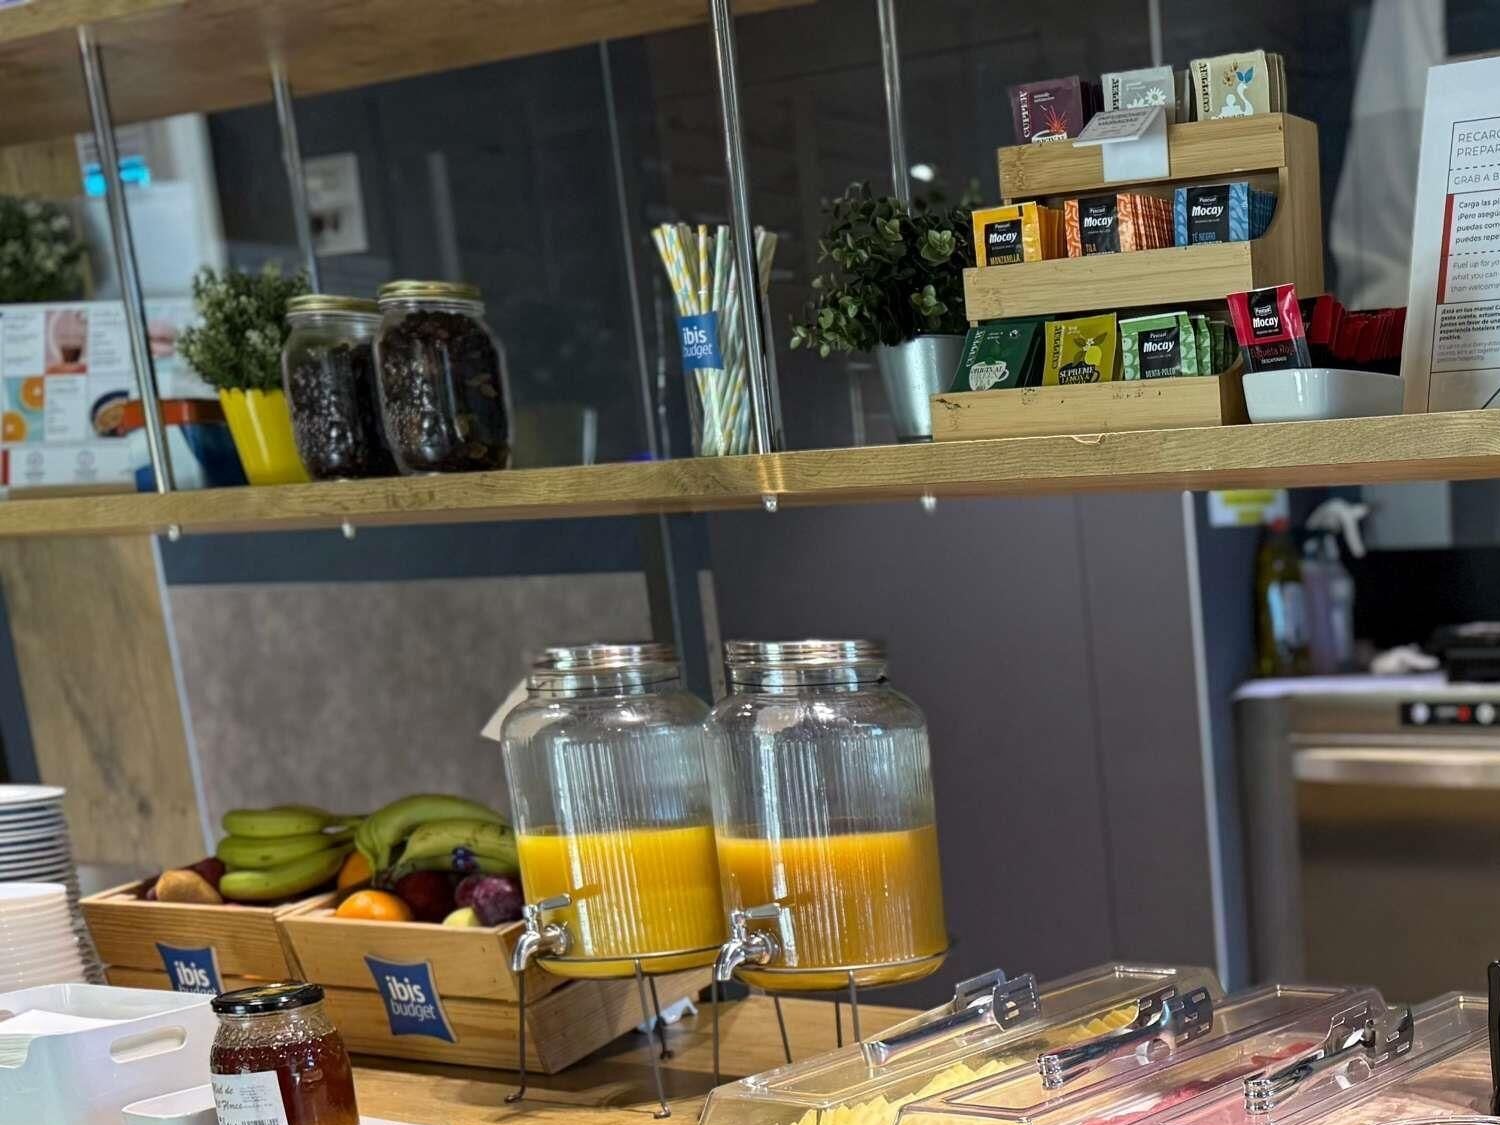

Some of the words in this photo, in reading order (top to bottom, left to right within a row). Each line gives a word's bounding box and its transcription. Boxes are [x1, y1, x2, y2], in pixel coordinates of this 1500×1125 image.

[1199, 63, 1210, 112] CUPPER
[1454, 175, 1480, 185] GRAB
[1484, 174, 1490, 182] A
[1459, 201, 1480, 209] Carga
[1192, 206, 1224, 217] Mocay
[1084, 216, 1113, 228] Mocay
[1457, 224, 1483, 232] puedas
[990, 232, 1017, 244] Mocay
[1453, 261, 1469, 269] Fuel
[1470, 260, 1479, 269] up
[1471, 273, 1482, 281] you
[1469, 283, 1500, 291] welcome
[1253, 317, 1279, 329] Mocay
[682, 325, 708, 345] ibis
[1143, 341, 1174, 352] Mocay
[175, 961, 211, 986] ibis
[386, 975, 425, 1003] ibis
[391, 1001, 437, 1022] budget
